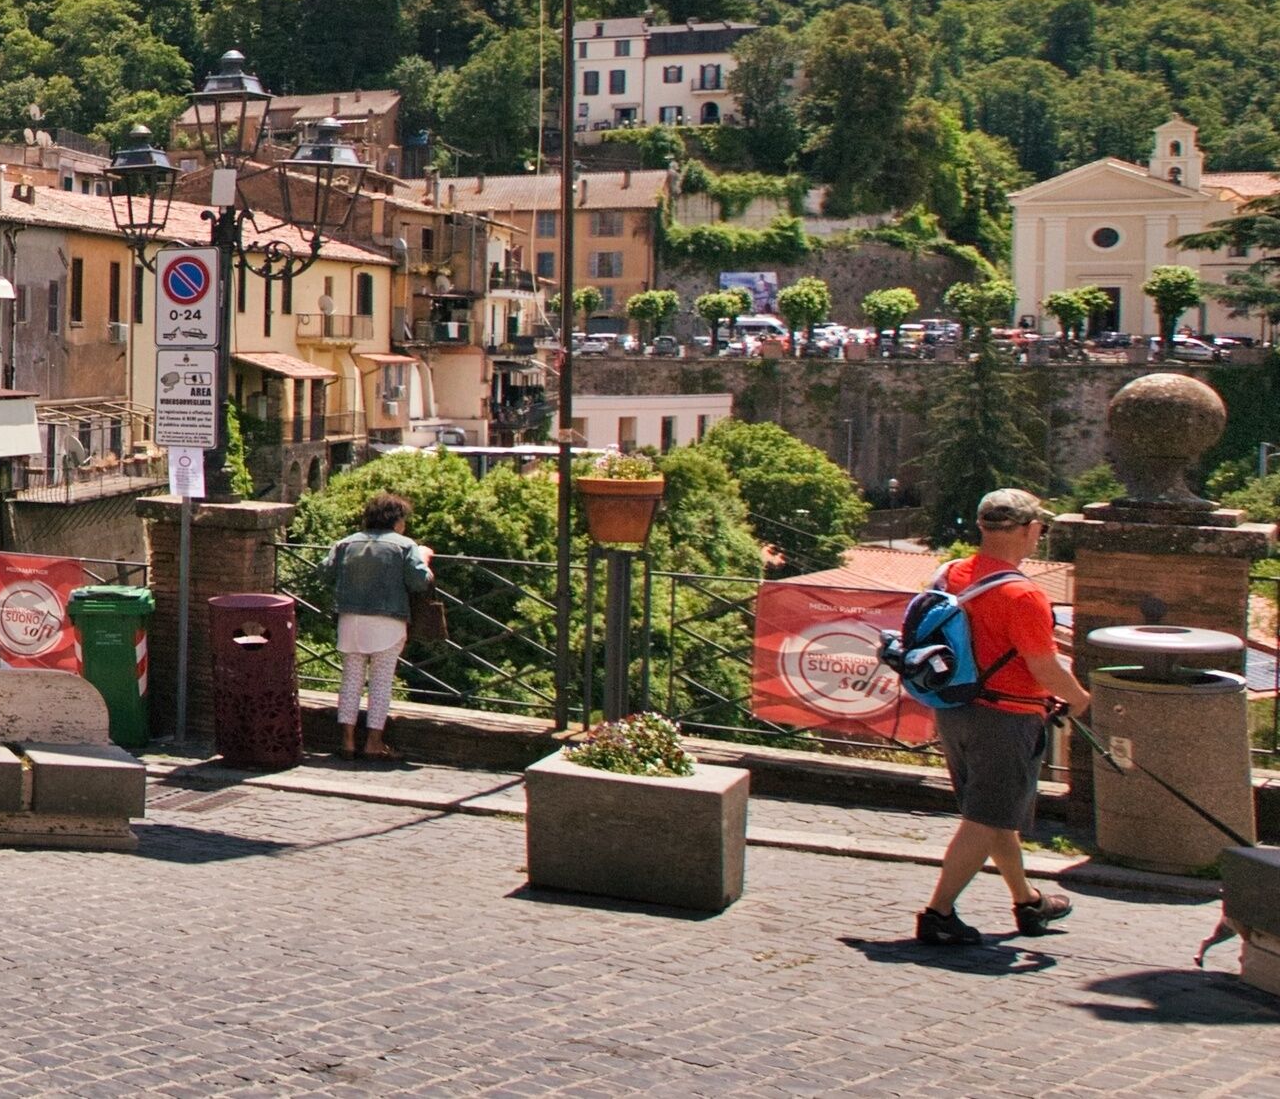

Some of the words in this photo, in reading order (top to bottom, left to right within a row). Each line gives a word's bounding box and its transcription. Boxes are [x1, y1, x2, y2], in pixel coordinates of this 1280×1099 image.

[169, 309, 202, 321] 0-24
[190, 387, 212, 397] AREA
[160, 398, 212, 406] VIDEOSORVEGLIATA
[808, 603, 838, 612] MEDIA
[5, 612, 40, 625] SUONO
[23, 624, 54, 642] soft
[808, 660, 868, 677] SUONO
[839, 676, 895, 698] soft
